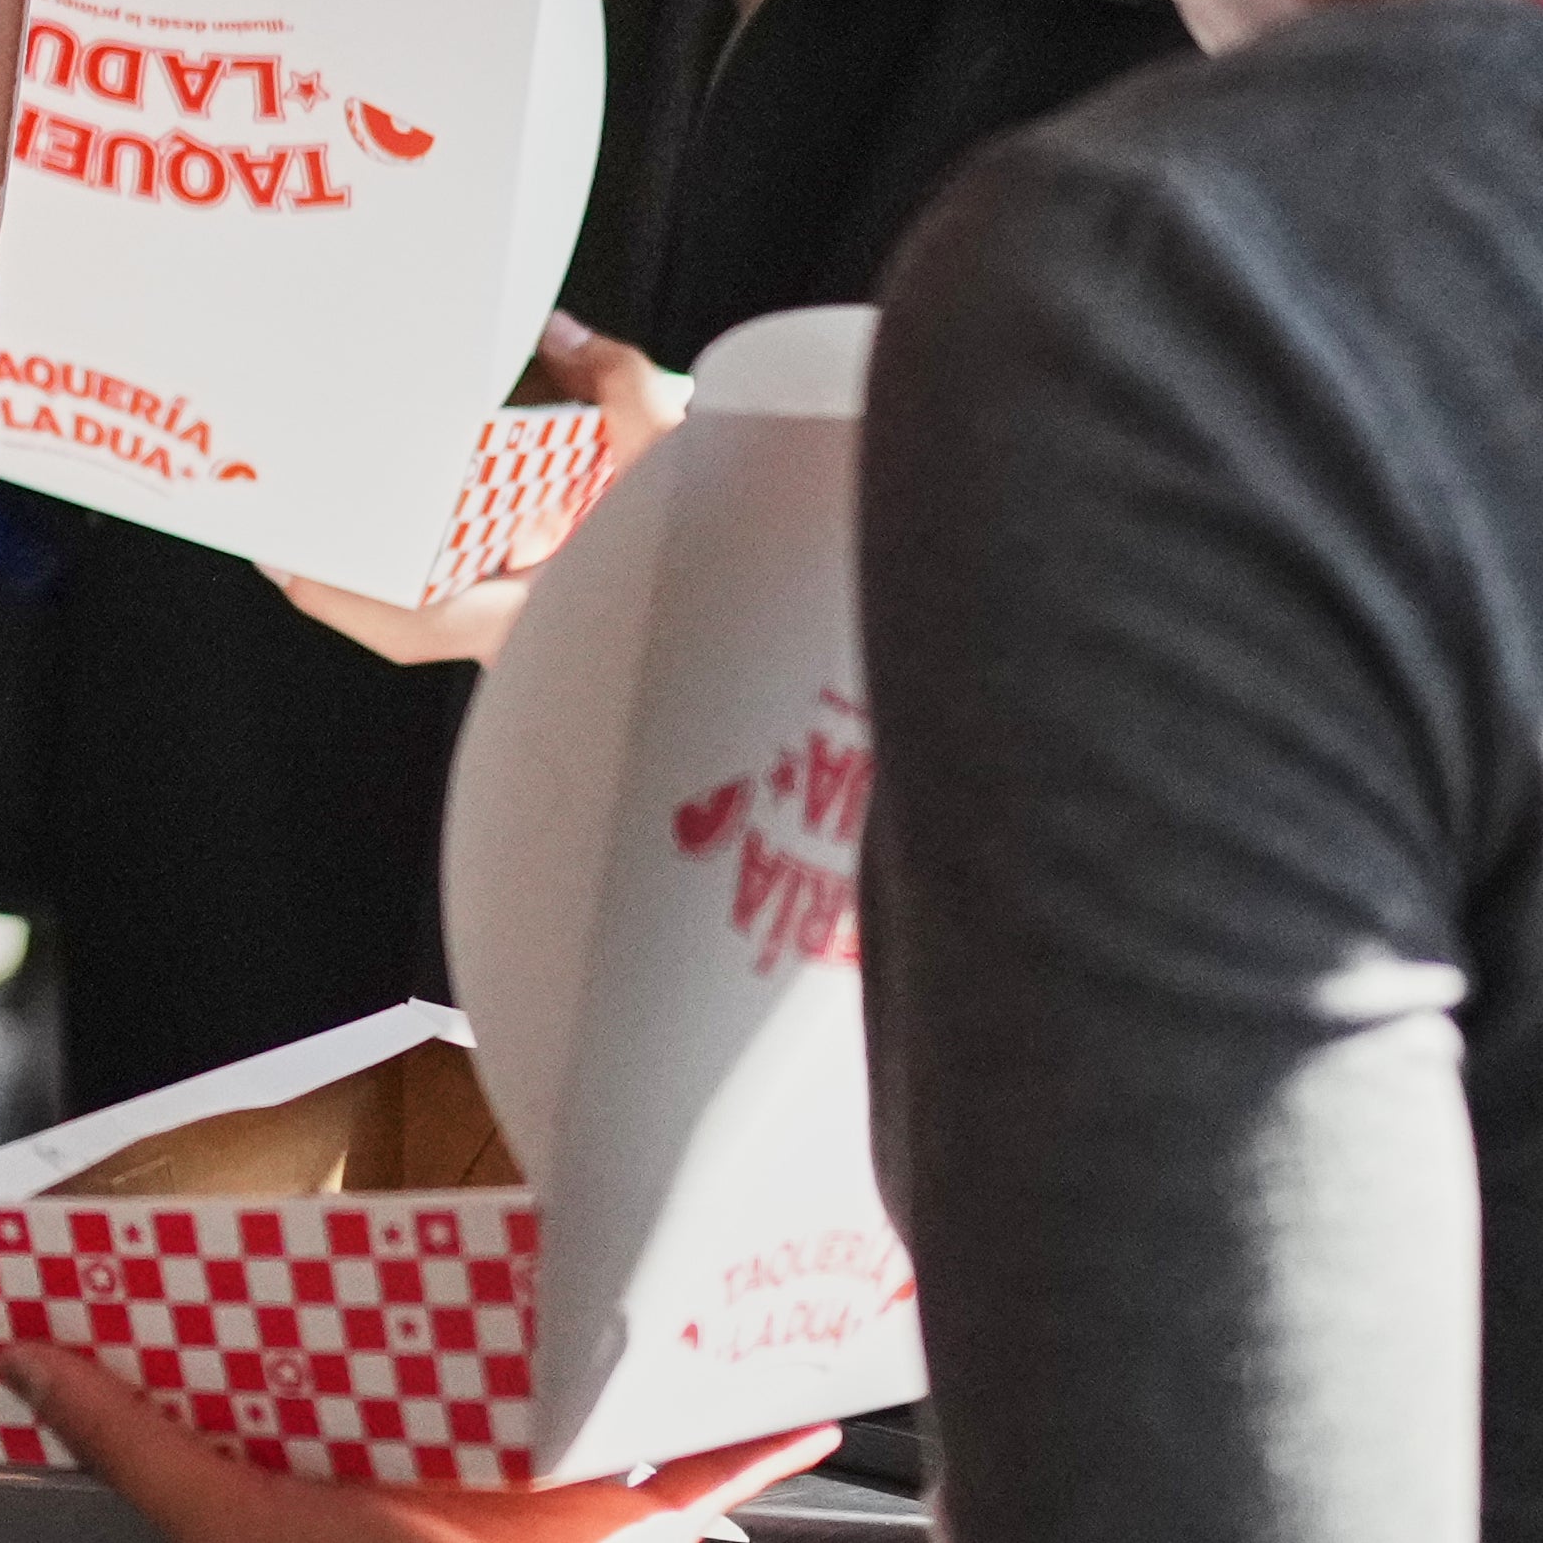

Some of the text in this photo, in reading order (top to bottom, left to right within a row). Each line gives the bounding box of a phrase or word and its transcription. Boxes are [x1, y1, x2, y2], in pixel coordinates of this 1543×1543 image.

[24, 17, 286, 123] LA DU
[0, 397, 64, 438] LA
[72, 412, 173, 480] DUA
